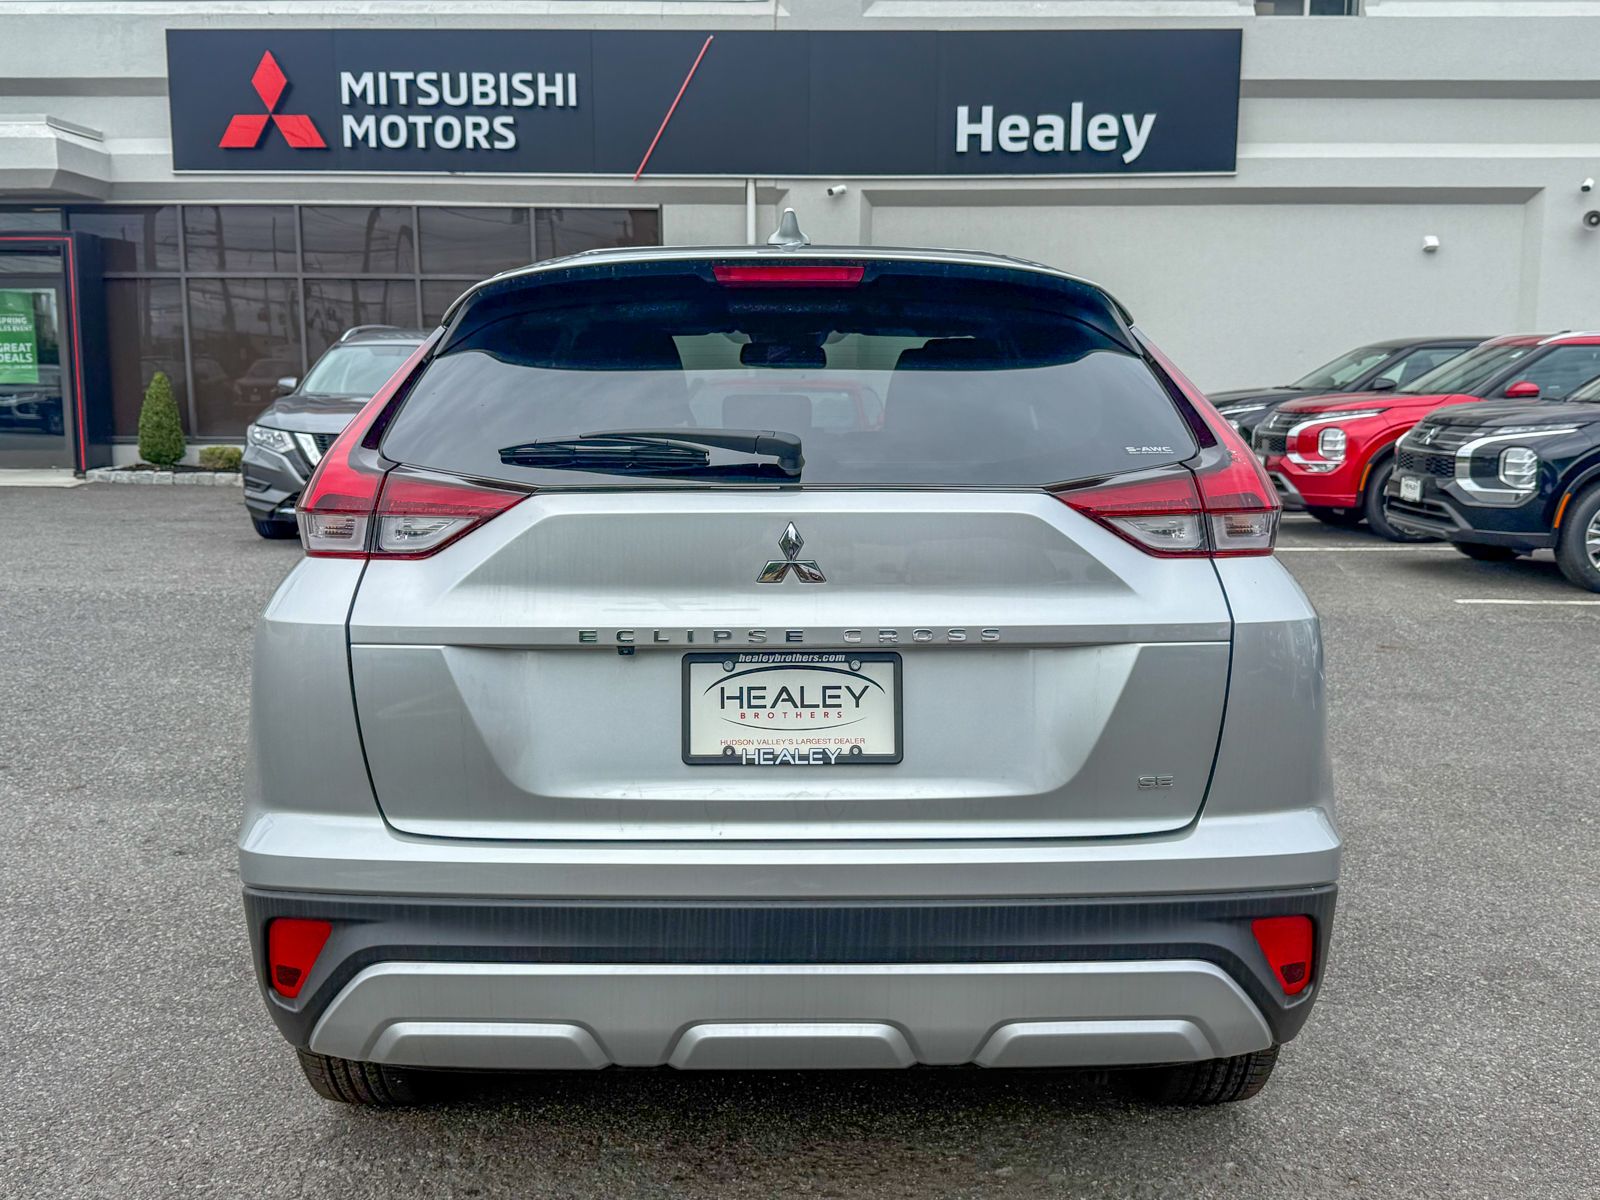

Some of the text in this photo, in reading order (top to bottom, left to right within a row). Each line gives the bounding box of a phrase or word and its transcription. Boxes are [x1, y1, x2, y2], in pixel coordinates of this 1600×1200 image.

[340, 71, 577, 107] MITSUBISHI
[342, 114, 517, 150] MOTORS
[956, 101, 1157, 164] Healey
[578, 628, 1000, 643] ECLIPSE CROSS
[738, 653, 845, 663] healeybrothers.com
[720, 685, 870, 710] HEALEY
[740, 711, 842, 719] BROTHERS
[742, 747, 842, 765] HEALEY
[1138, 776, 1174, 788] SE
